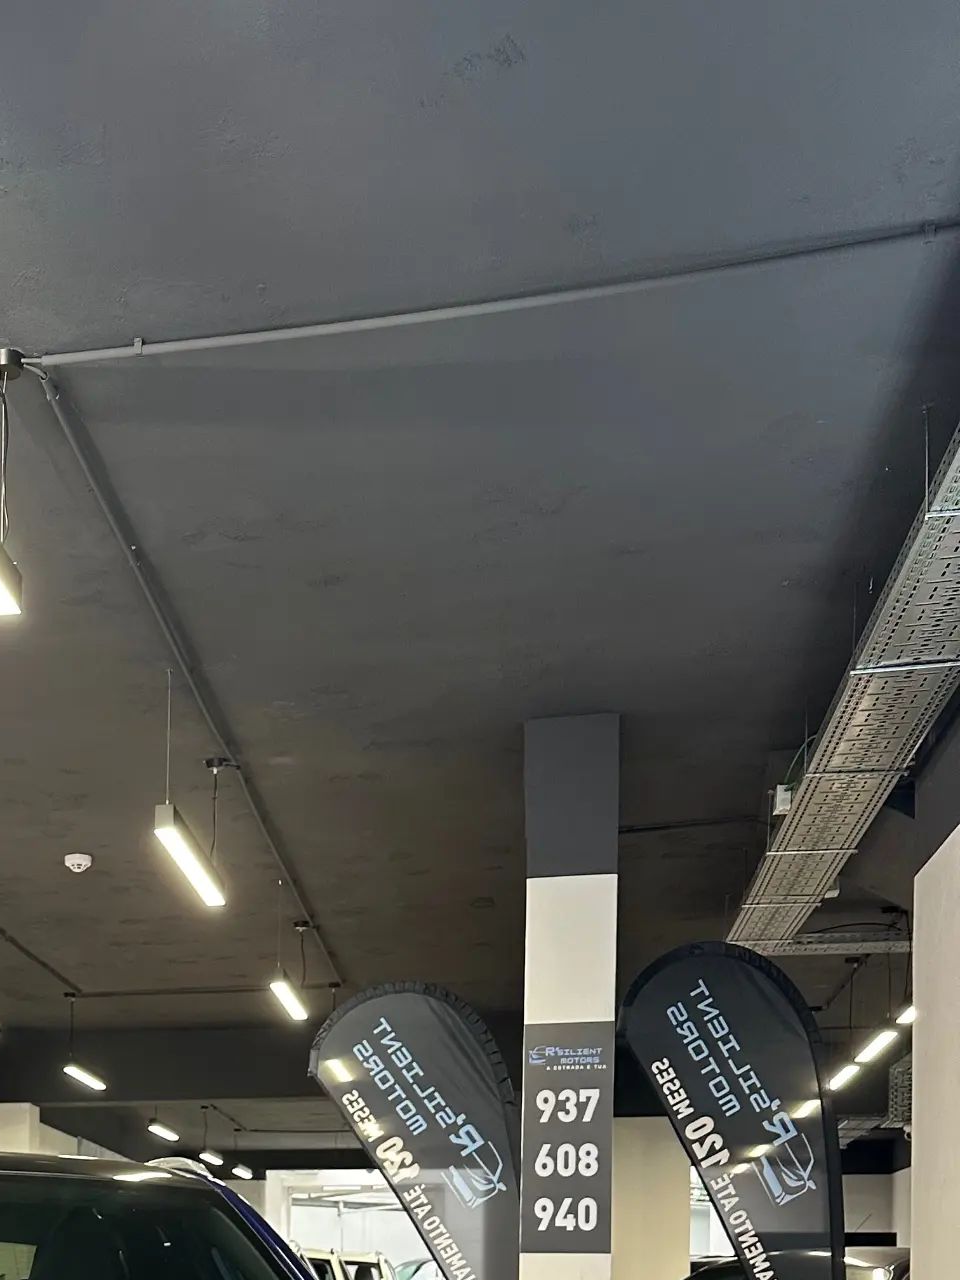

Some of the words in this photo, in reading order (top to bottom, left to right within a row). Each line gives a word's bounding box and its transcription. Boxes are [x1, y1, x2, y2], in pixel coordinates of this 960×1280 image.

[560, 1056, 600, 1064] MOTORS
[536, 1088, 600, 1123] 937
[534, 1142, 599, 1178] 608
[533, 1197, 599, 1232] 940
